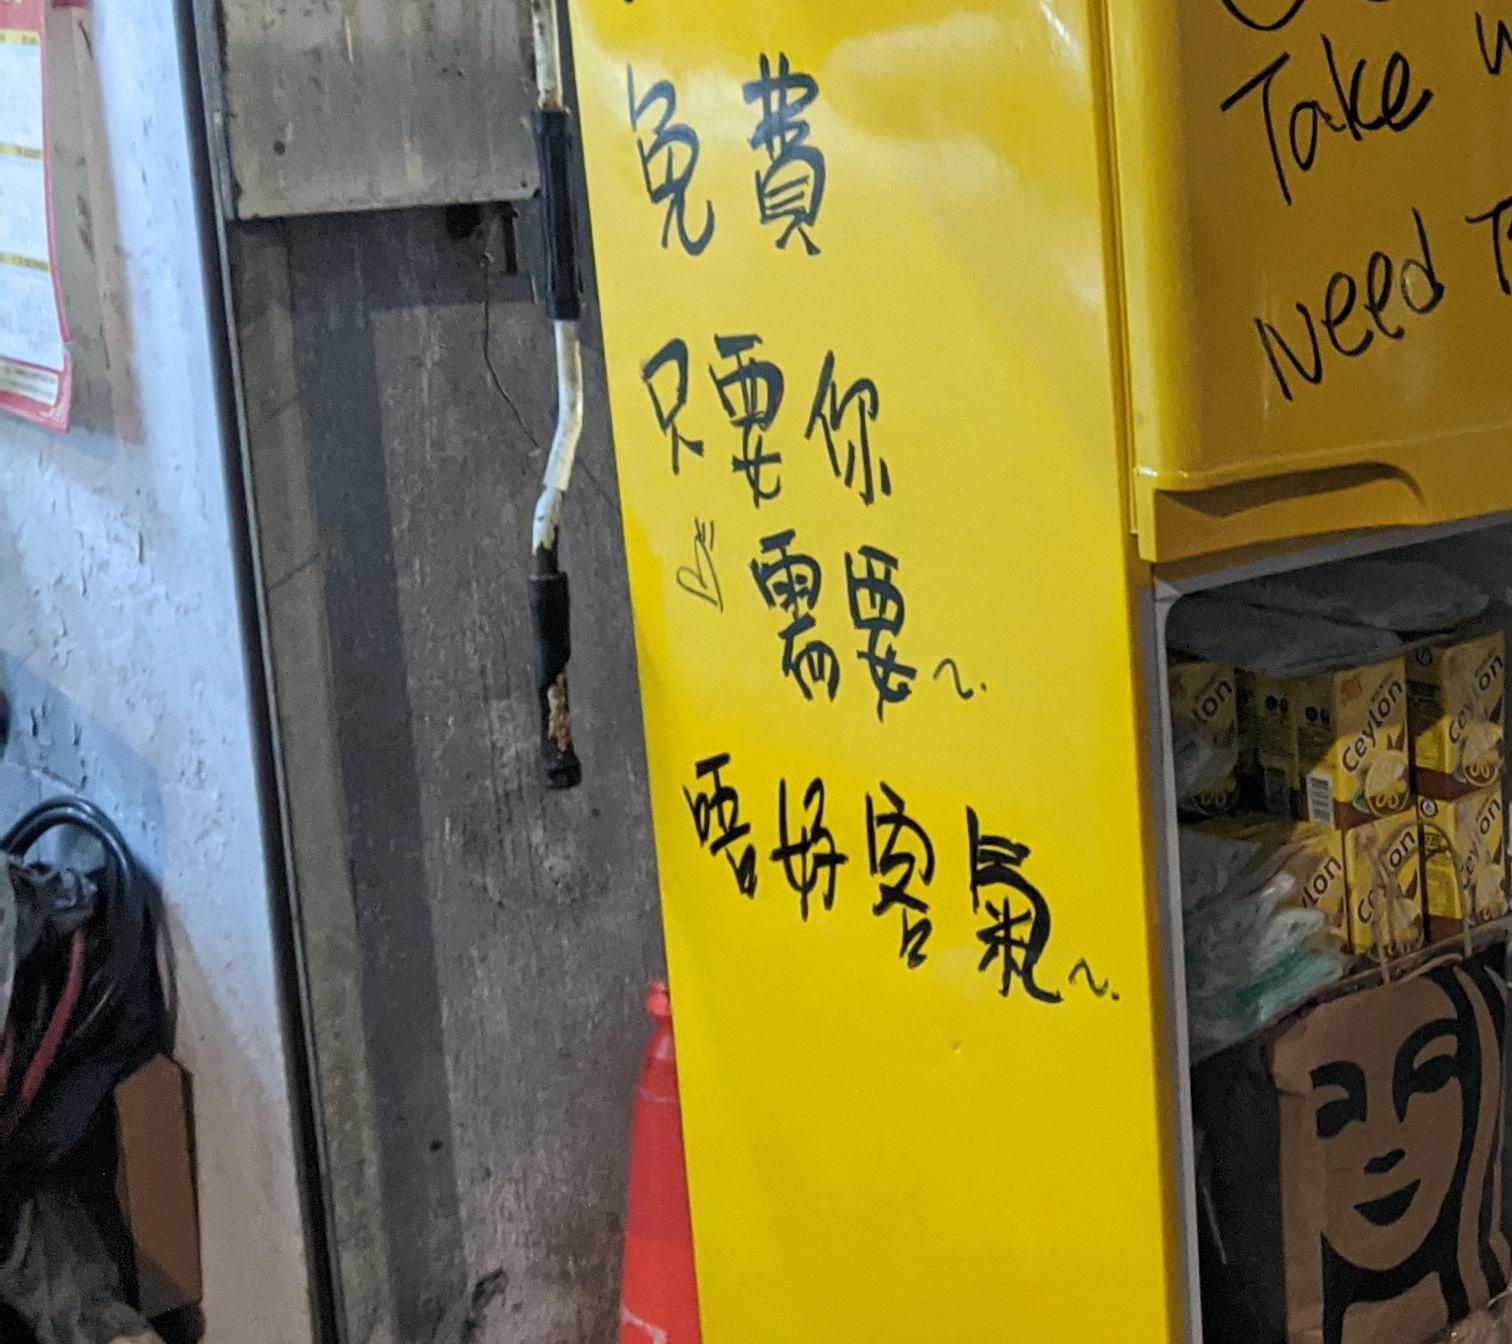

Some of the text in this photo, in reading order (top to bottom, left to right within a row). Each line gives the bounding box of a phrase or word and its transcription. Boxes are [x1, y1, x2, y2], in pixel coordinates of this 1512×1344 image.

[625, 51, 827, 256] 免費
[1221, 33, 1433, 206] Take
[1253, 207, 1445, 401] Need
[640, 333, 892, 507] 只要你
[1342, 678, 1403, 773] Ceylon
